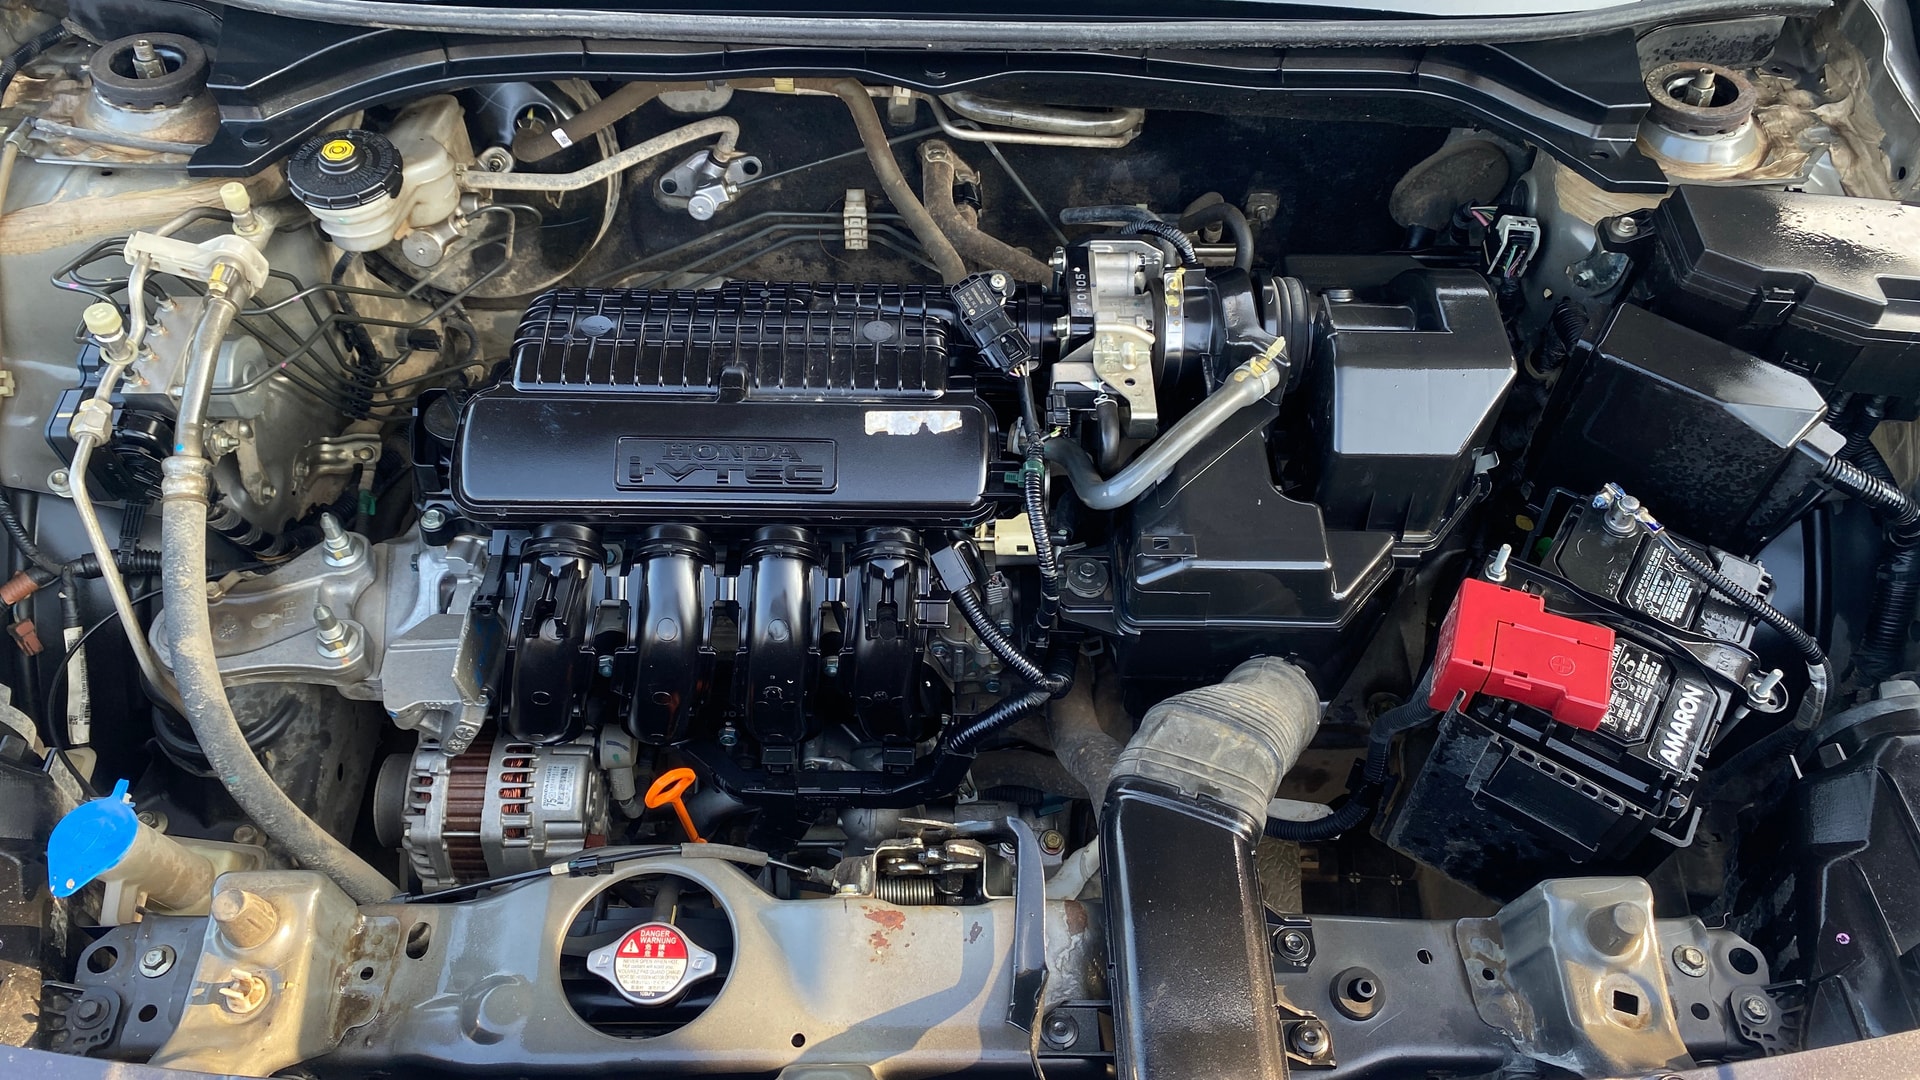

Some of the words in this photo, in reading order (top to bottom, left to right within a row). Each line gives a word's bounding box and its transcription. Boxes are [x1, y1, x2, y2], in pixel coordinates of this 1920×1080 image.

[1075, 273, 1087, 313] 210105
[662, 442, 803, 463] HONDA
[629, 456, 824, 486] i-VTEC
[1660, 684, 1704, 766] AMARON
[640, 936, 677, 944] WARNUNG
